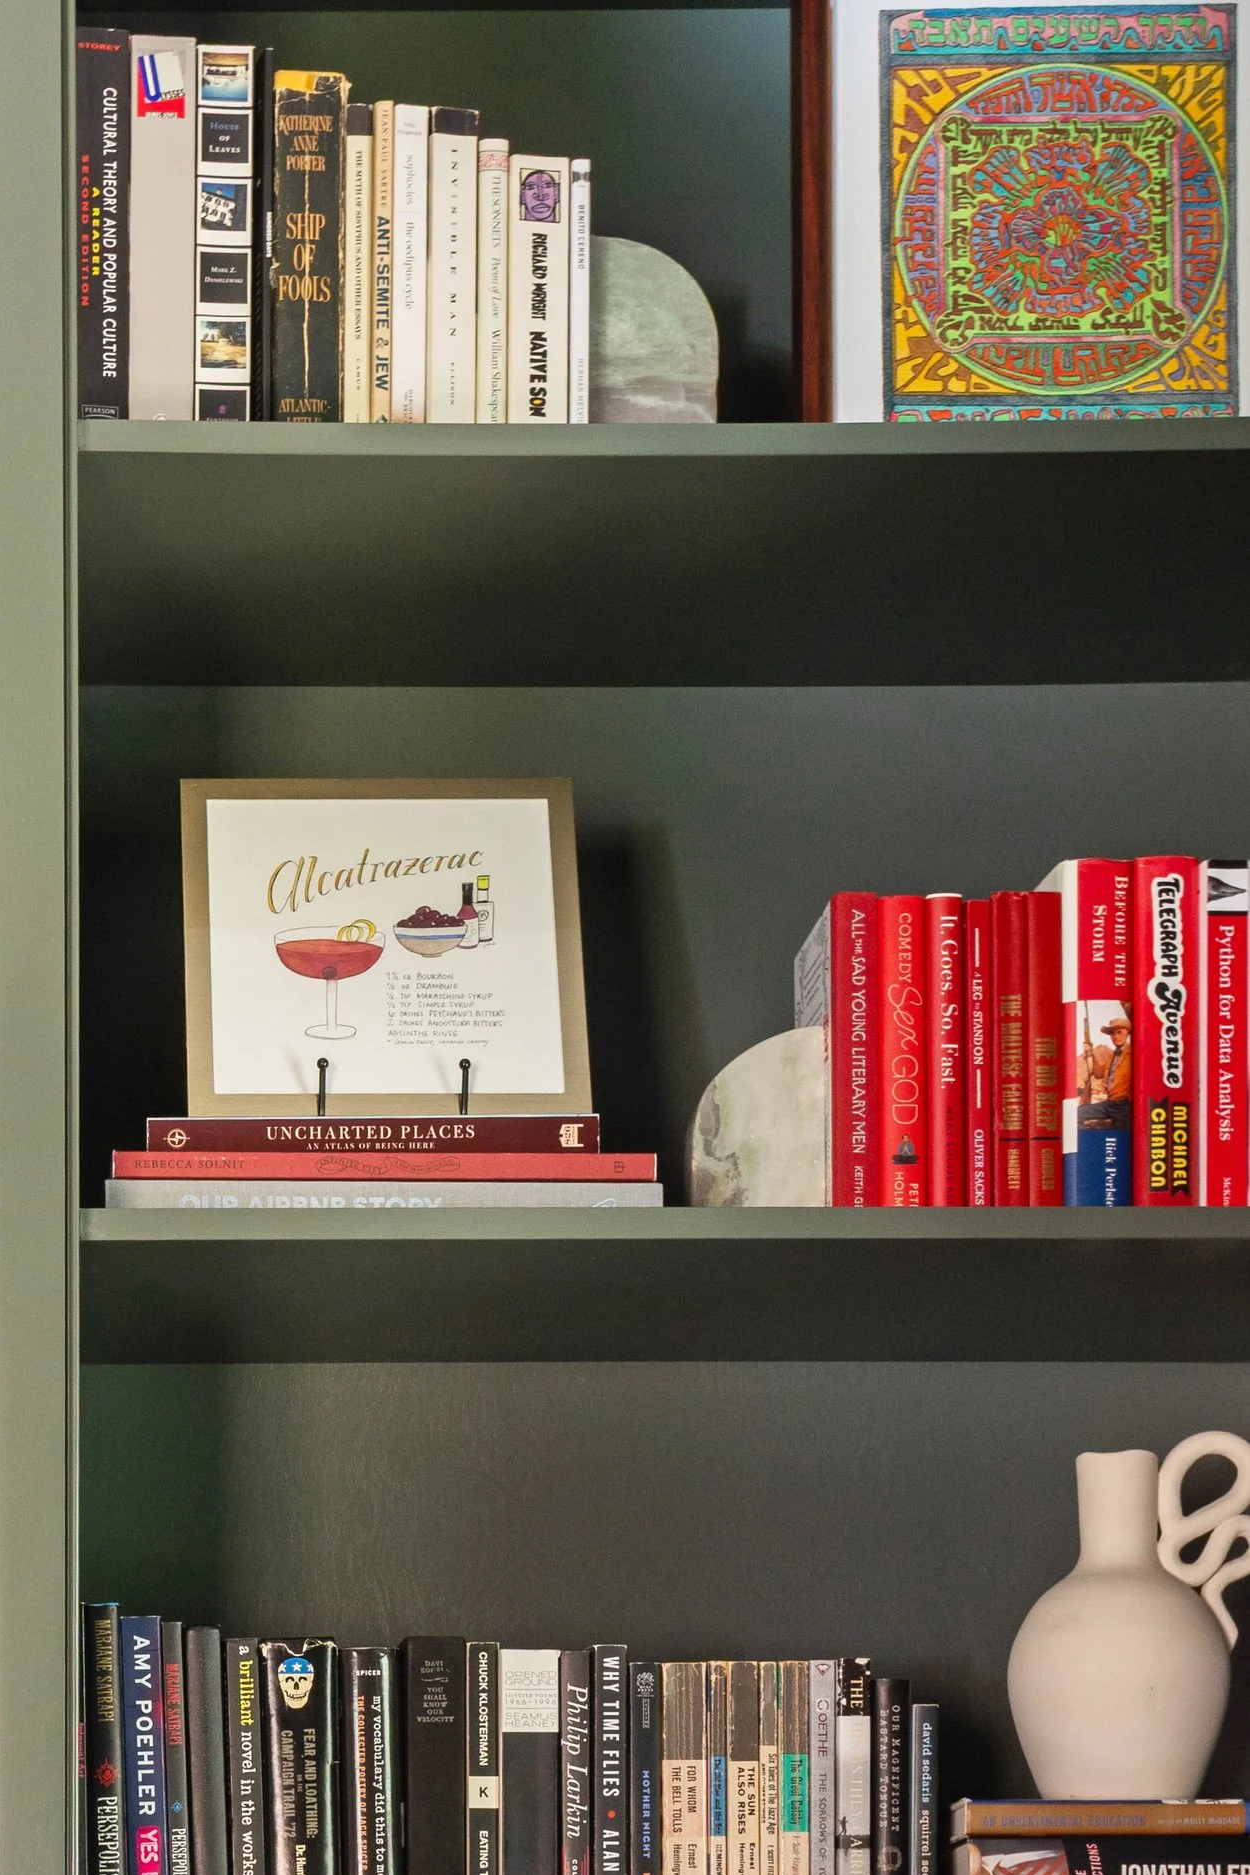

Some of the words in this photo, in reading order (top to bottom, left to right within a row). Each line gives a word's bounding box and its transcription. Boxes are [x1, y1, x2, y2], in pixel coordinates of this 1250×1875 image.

[103, 87, 117, 157] CULTURAL
[103, 163, 117, 213] THEORY
[103, 219, 117, 249] AND
[532, 234, 547, 280] RICHARD
[103, 254, 117, 317] POPULAR
[532, 283, 547, 320] WRIGHT
[103, 320, 117, 378] CULTURE
[529, 331, 547, 377] NATIVE
[529, 381, 547, 418] SON
[267, 848, 483, 915] Alcatrazerac
[1157, 877, 1180, 977] TELEGRAPH
[1218, 926, 1236, 987] Python
[1218, 995, 1236, 1016] for
[1157, 984, 1180, 1084] Avenue
[1218, 1021, 1236, 1063] Data
[1218, 1070, 1236, 1142] Analysis
[266, 1124, 391, 1142] UNCHARTED
[401, 1123, 475, 1140] PLACES
[1152, 1108, 1165, 1187] CHABON
[1173, 1106, 1187, 1192] MICHAEL
[133, 1635, 151, 1689] AMY
[479, 1652, 487, 1692] CHUCK
[603, 1657, 619, 1693] WHY
[479, 1695, 488, 1766] KLOSTERMAN
[603, 1700, 619, 1743] TIME
[136, 1700, 154, 1816] POEHLER
[603, 1750, 619, 1797] FLIES
[140, 1829, 157, 1861] YES
[479, 1830, 488, 1868] EATING
[603, 1830, 619, 1875] ALAN
